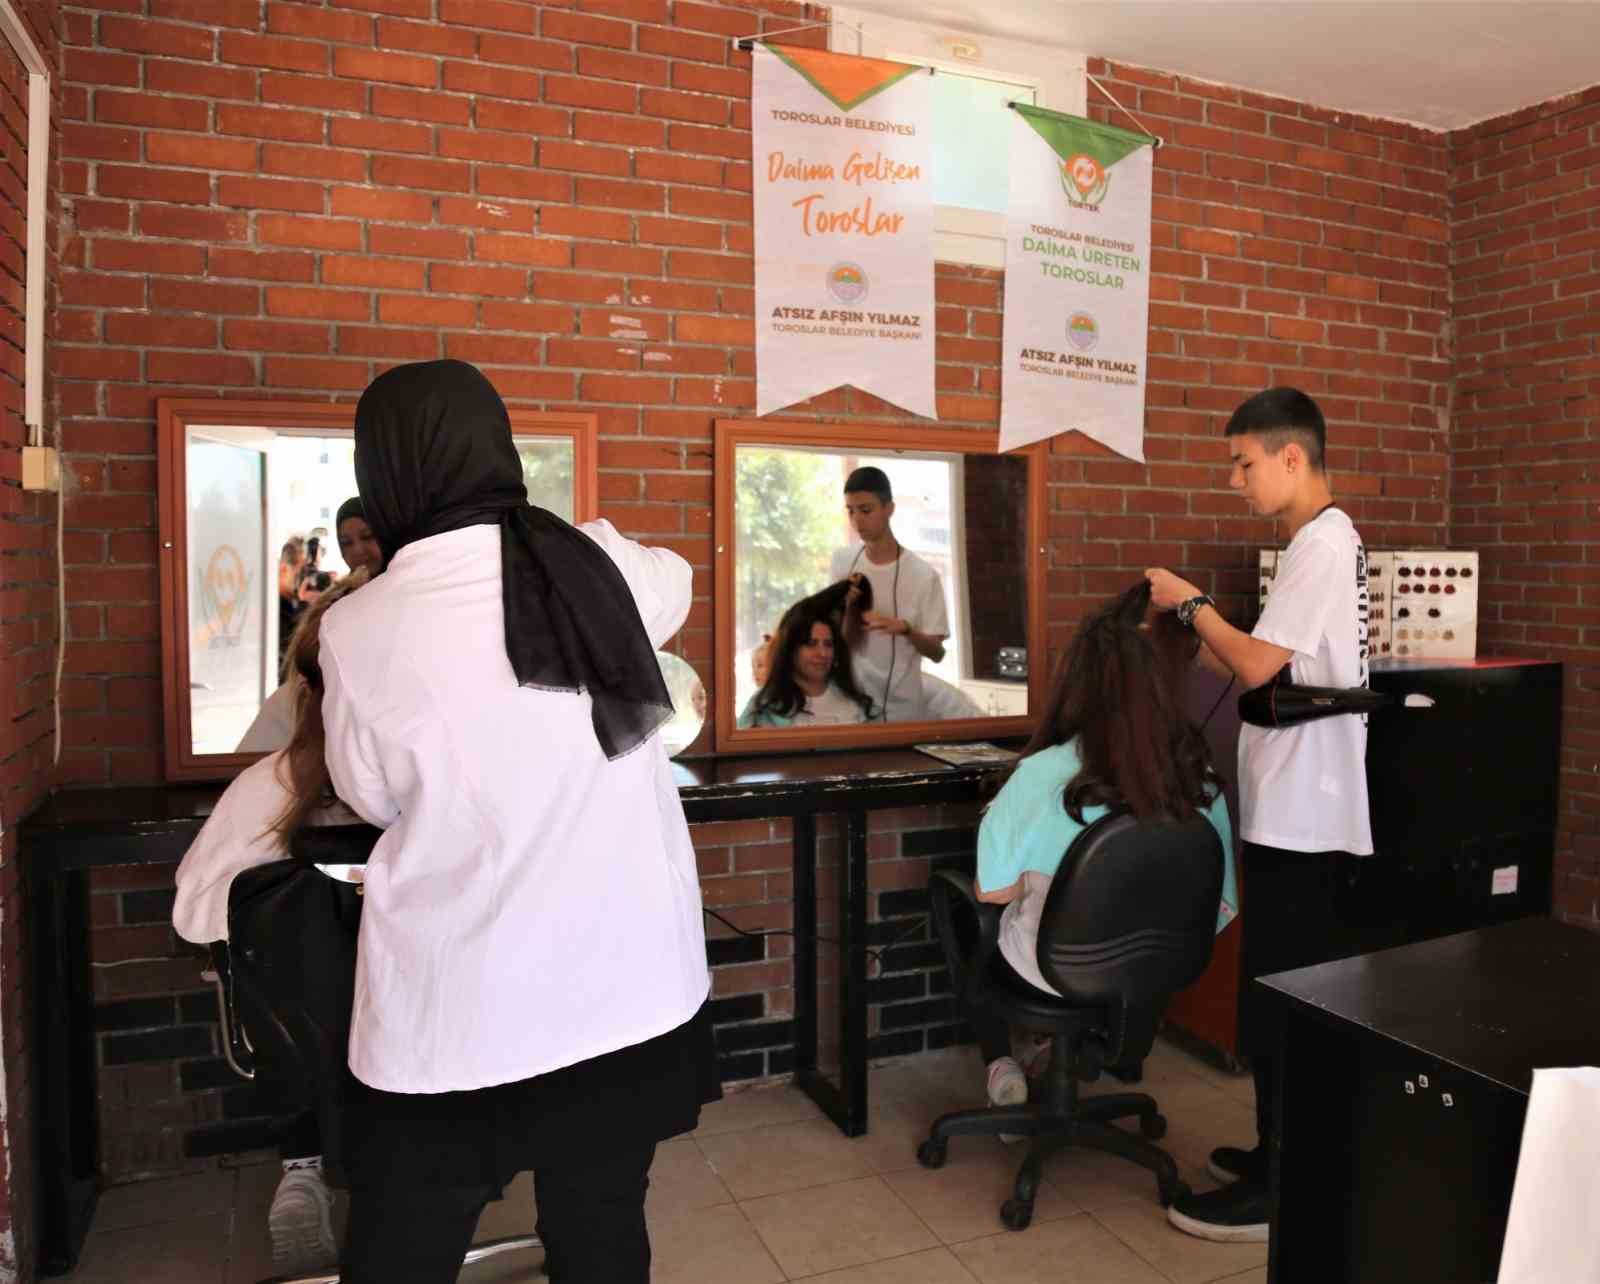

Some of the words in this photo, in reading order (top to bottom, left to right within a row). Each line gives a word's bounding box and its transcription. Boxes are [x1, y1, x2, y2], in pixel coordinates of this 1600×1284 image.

[771, 109, 841, 127] TOROSLAR
[767, 151, 835, 183] Daima
[843, 151, 921, 185] Gelişen
[792, 192, 904, 237] Toroslar
[1030, 224, 1082, 242] TOROSLAR
[1023, 236, 1077, 260] DAİMA
[1040, 261, 1125, 289] TOROSLAR
[772, 306, 816, 321] ATSIZ
[867, 312, 921, 327] YILMAZ
[772, 323, 827, 335] TOROSLAR
[1020, 348, 1056, 363] ATSIZ
[1096, 359, 1137, 375] YILMAZ
